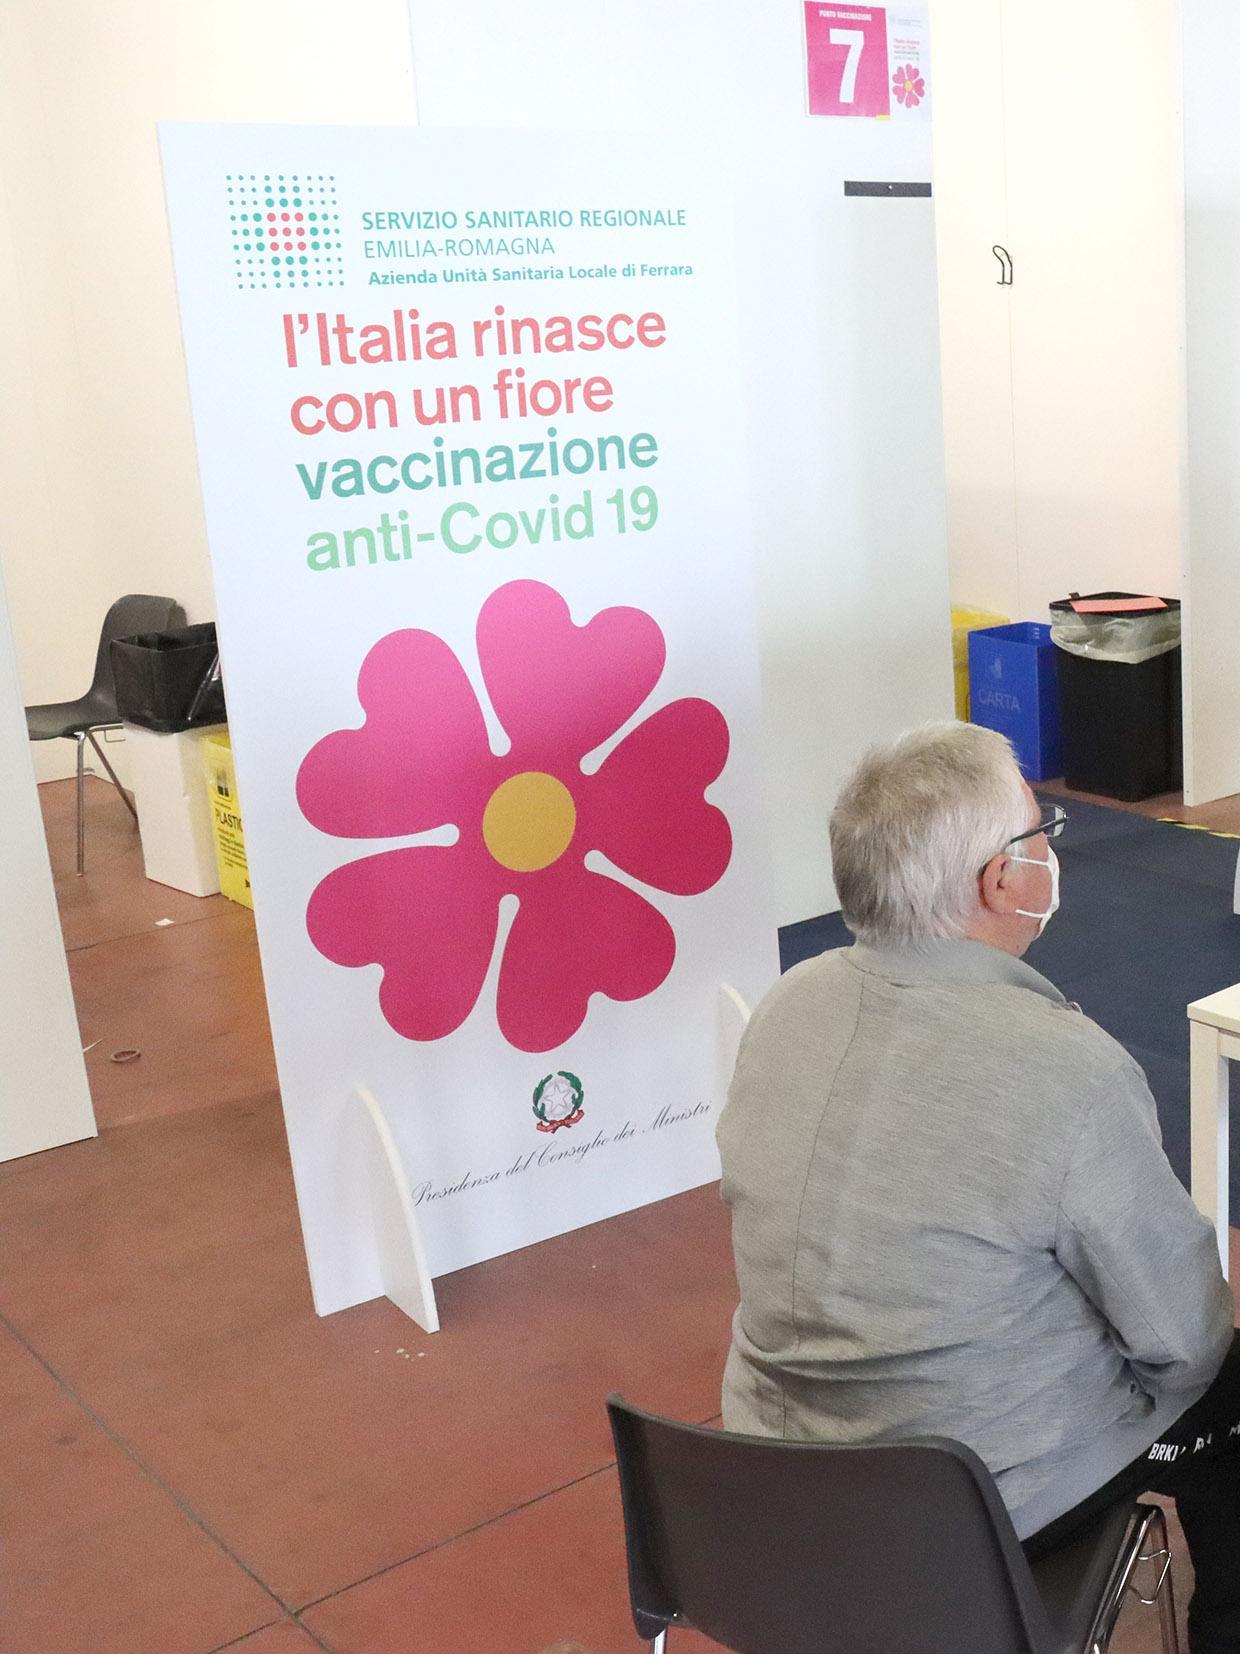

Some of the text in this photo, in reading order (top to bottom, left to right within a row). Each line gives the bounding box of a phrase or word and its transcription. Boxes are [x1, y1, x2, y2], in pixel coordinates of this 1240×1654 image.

[829, 28, 865, 104] 7
[362, 209, 686, 230] SERVIZIO SANITARIO REGIONALE
[364, 237, 555, 259] EMILIA-ROMAGNA
[368, 263, 693, 285] Azienda Unità Sanitaria Locale di Ferrara
[282, 305, 666, 368] l'Italia rinasce
[290, 367, 614, 435] con un fiore
[295, 427, 659, 500] vaccinazione
[305, 485, 659, 571] anti-Covid 19
[977, 688, 1021, 713] CARTA
[410, 1100, 712, 1207] Presidenza del Consiglio dei Ministri
